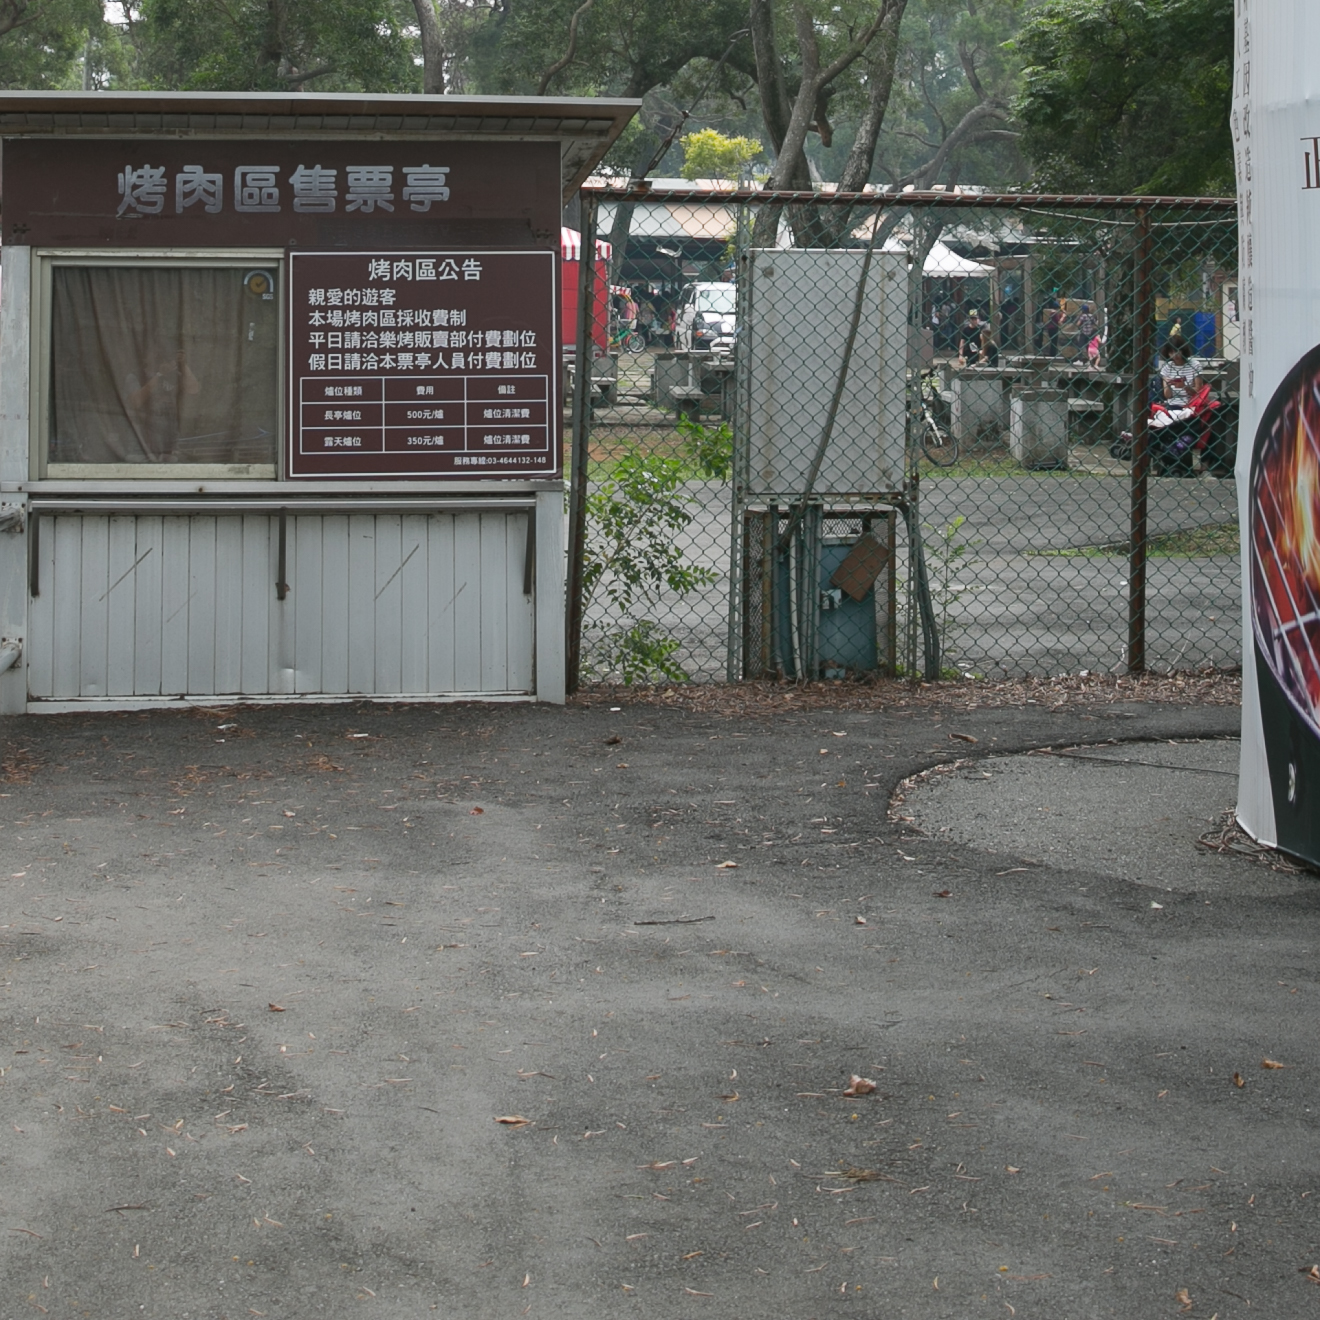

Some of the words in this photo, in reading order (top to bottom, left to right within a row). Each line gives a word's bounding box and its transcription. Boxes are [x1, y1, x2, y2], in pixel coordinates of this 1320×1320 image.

[117, 164, 450, 216] 烤肉區售票亭
[368, 258, 482, 281] 烤肉區公告
[308, 288, 396, 306] 親愛的遊客
[308, 309, 467, 327] 本場烤肉區採收費制
[308, 330, 537, 349] 平日請洽樂烤販賣部付費劃位
[308, 352, 537, 370] 假日請洽本票亭人員付費劃位
[416, 385, 434, 396] 費用
